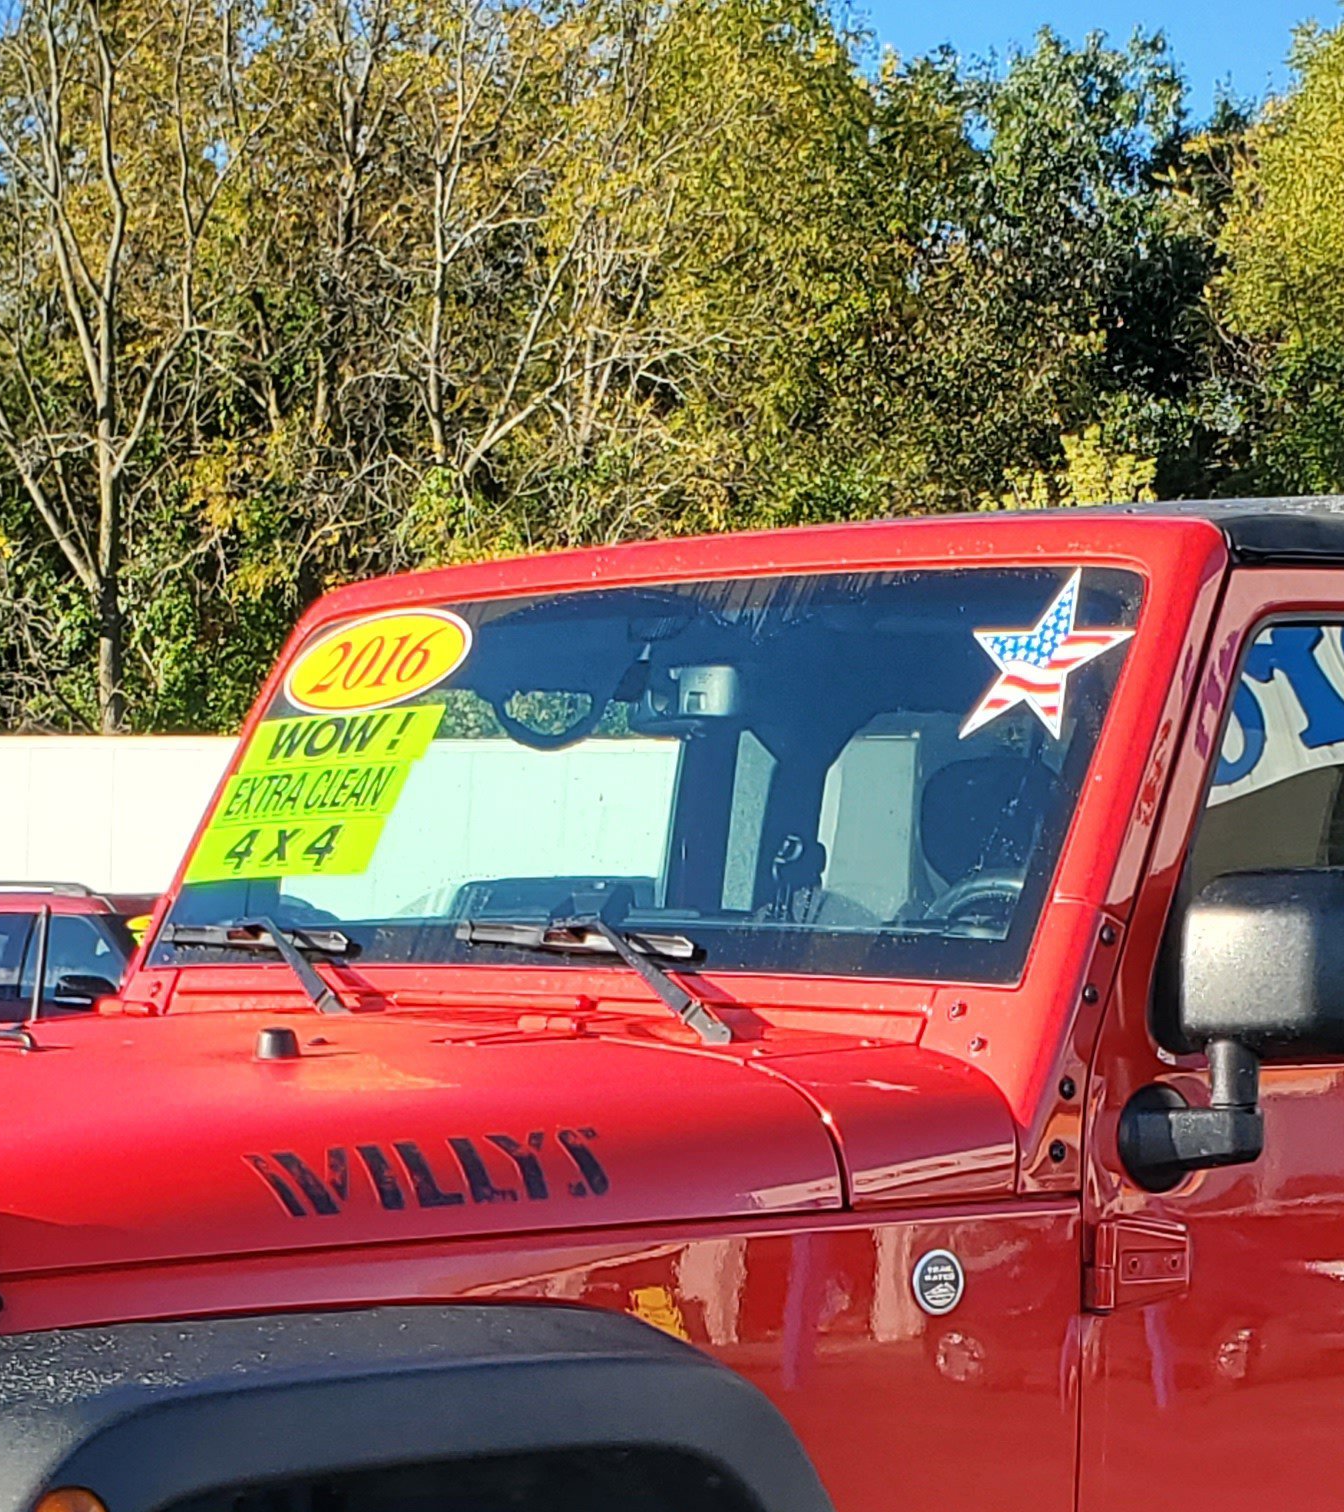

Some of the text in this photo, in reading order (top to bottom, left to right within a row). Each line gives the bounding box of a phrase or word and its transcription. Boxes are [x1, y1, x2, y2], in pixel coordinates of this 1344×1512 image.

[306, 627, 448, 695] 2016
[223, 765, 397, 820] EXTRA CLEAN
[242, 1127, 610, 1218] WILLYS
